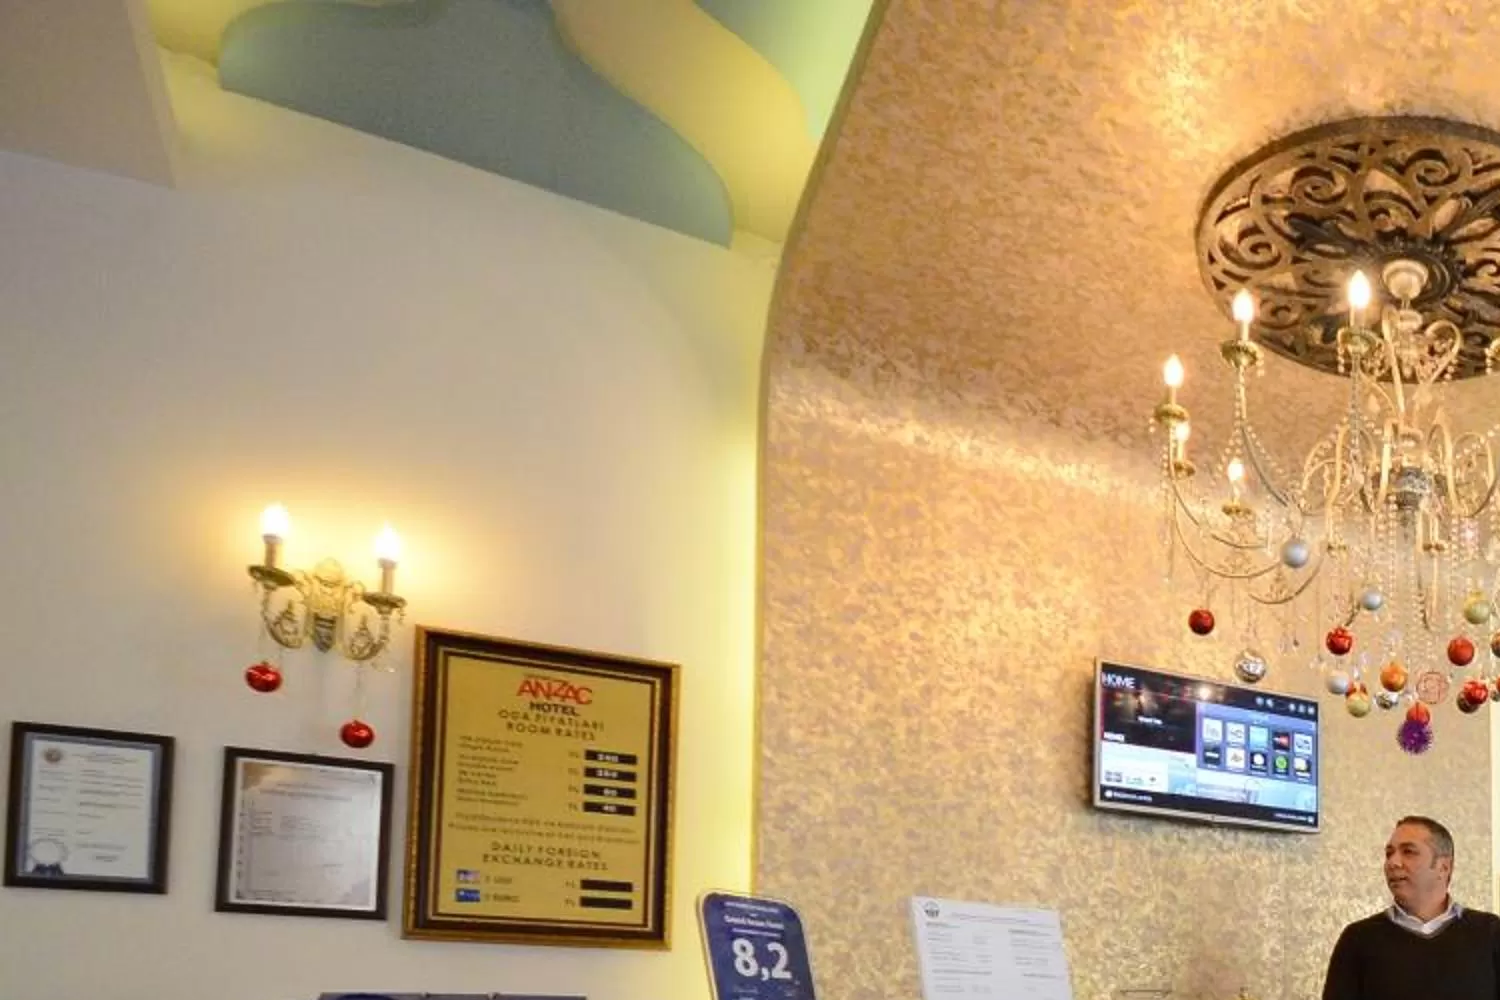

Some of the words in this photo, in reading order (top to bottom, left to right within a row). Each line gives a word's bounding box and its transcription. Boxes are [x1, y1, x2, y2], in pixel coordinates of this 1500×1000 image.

[516, 676, 593, 705] ANZAC
[1101, 671, 1136, 689] HOME
[529, 701, 581, 716] HOTEL
[732, 938, 793, 981] 8,2
